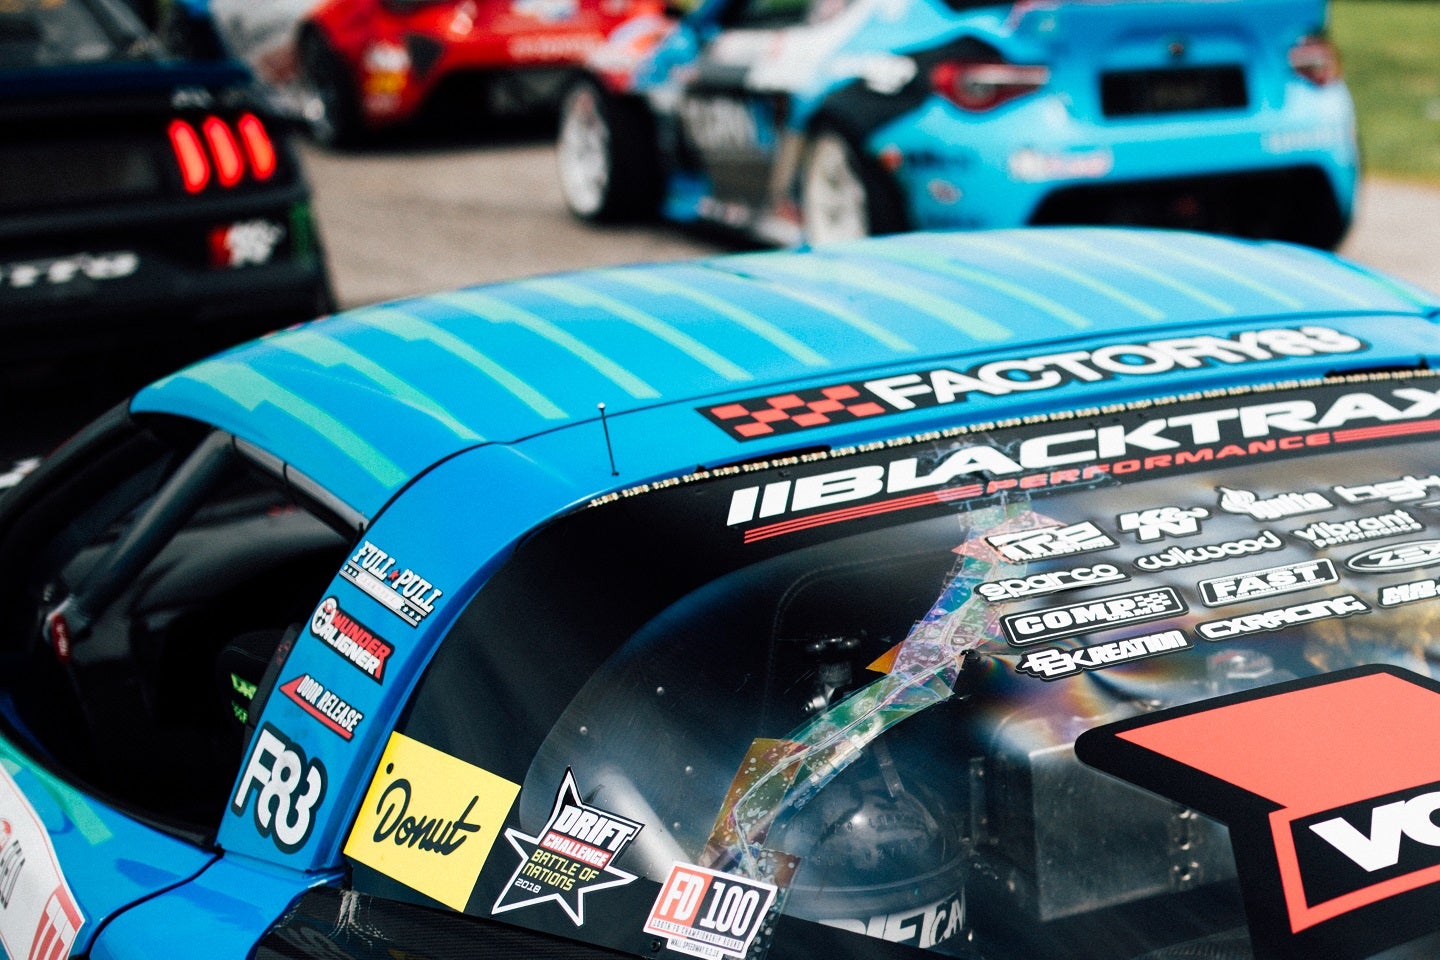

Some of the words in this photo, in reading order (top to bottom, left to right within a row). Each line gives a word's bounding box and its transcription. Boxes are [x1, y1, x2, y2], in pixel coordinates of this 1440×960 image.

[864, 326, 1363, 411] FACTORY83
[982, 431, 1336, 494] PERFORMANCE
[1138, 530, 1283, 570] wilwood
[352, 540, 396, 581] FULL
[390, 568, 443, 614] PULL
[979, 564, 1126, 602] sparco
[1212, 562, 1320, 599] FAST
[331, 608, 392, 670] WUNDER
[1013, 597, 1136, 636] COMP
[1200, 595, 1367, 638] CXRACING
[320, 624, 381, 676] ALIGNER
[295, 673, 325, 704] DOOR
[316, 690, 363, 733] RELEASE
[234, 728, 322, 846] F83
[374, 772, 482, 857] Donut
[552, 804, 637, 851] DRIFT
[530, 849, 578, 876] BATTLE
[578, 866, 600, 882] OF
[543, 833, 611, 867] CHALLENGE
[514, 878, 542, 894] 2018
[523, 863, 577, 892] NATIONS
[659, 870, 705, 921] FD
[699, 880, 760, 937] 100
